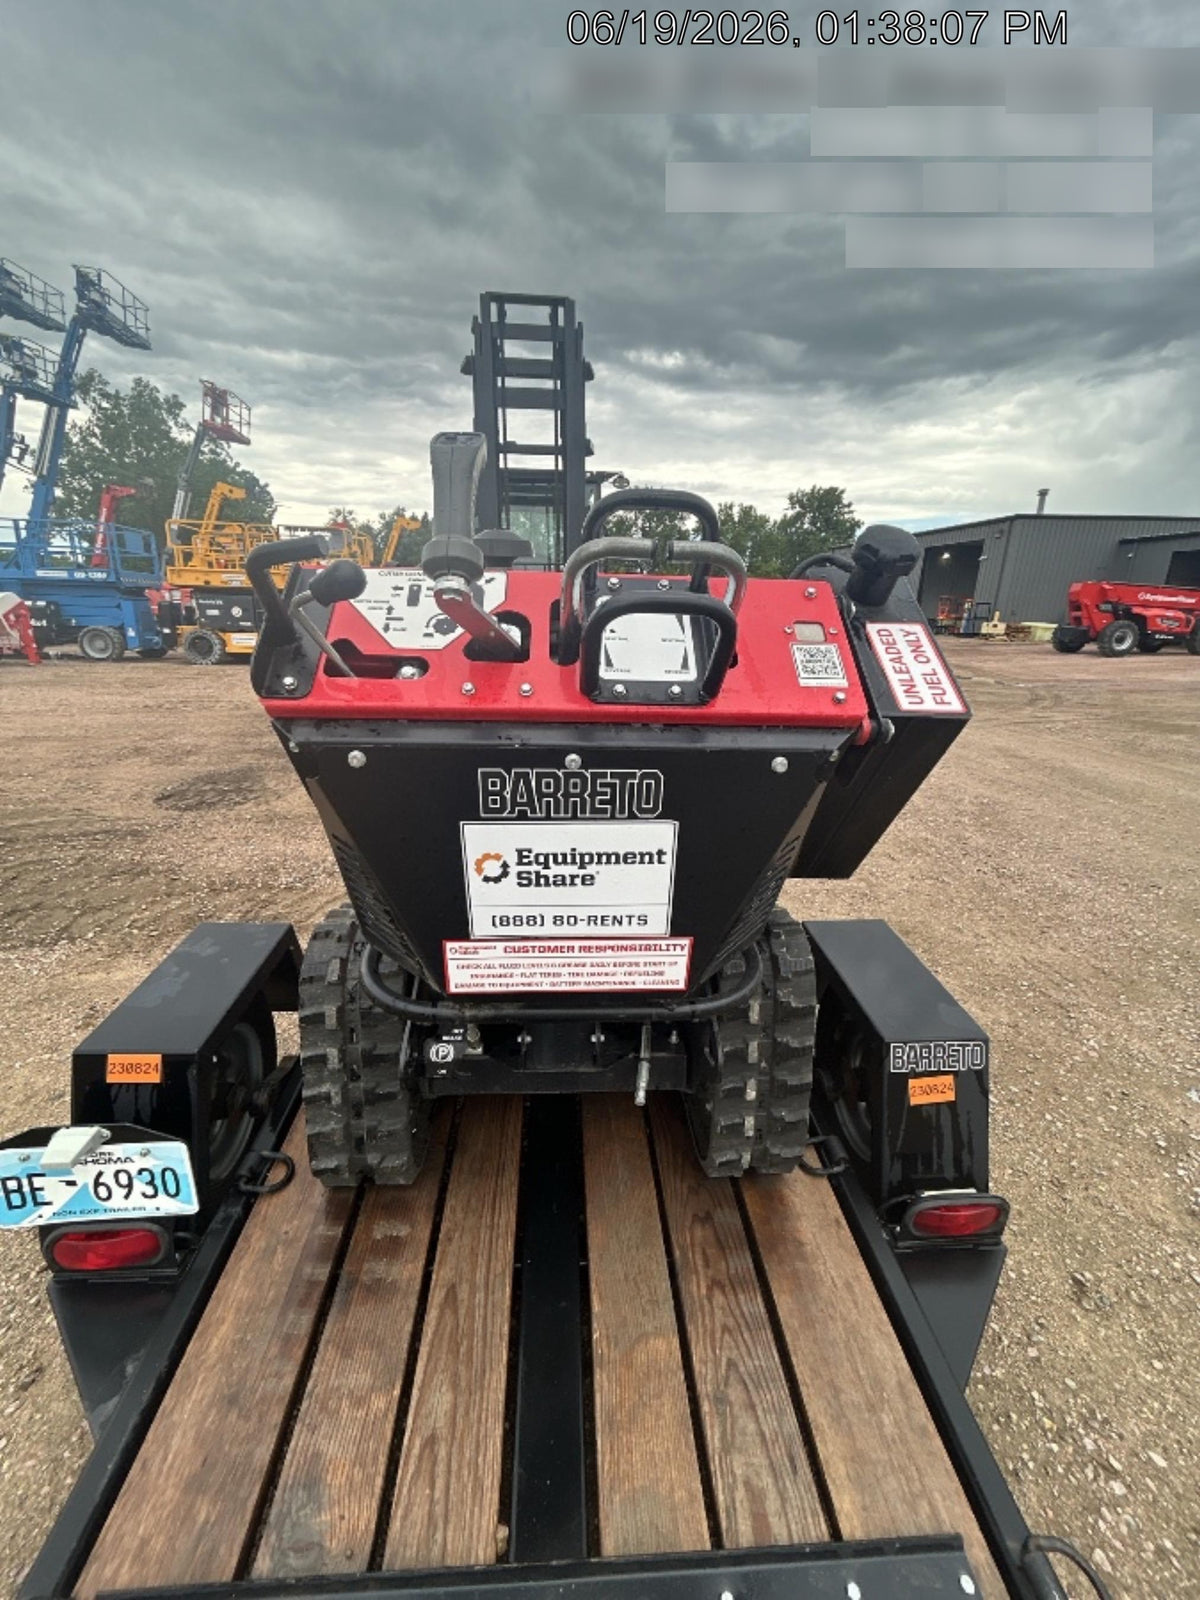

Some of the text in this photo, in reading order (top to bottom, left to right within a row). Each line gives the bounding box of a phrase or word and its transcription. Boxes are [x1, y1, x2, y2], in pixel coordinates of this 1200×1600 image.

[876, 628, 924, 705] UNLEADED
[901, 628, 952, 706] FUEL ONLY
[477, 768, 664, 818] BARRETO
[515, 847, 667, 870] Equipment
[516, 871, 597, 888] Share
[491, 913, 649, 928] (888) 80-RENTS
[503, 943, 687, 954] CUSTOMER RESPONSIBILITY
[108, 1062, 160, 1075] 230824
[890, 1041, 985, 1073] BARRETO
[909, 1081, 954, 1098] 230824
[0, 1166, 181, 1211] BE 6930
